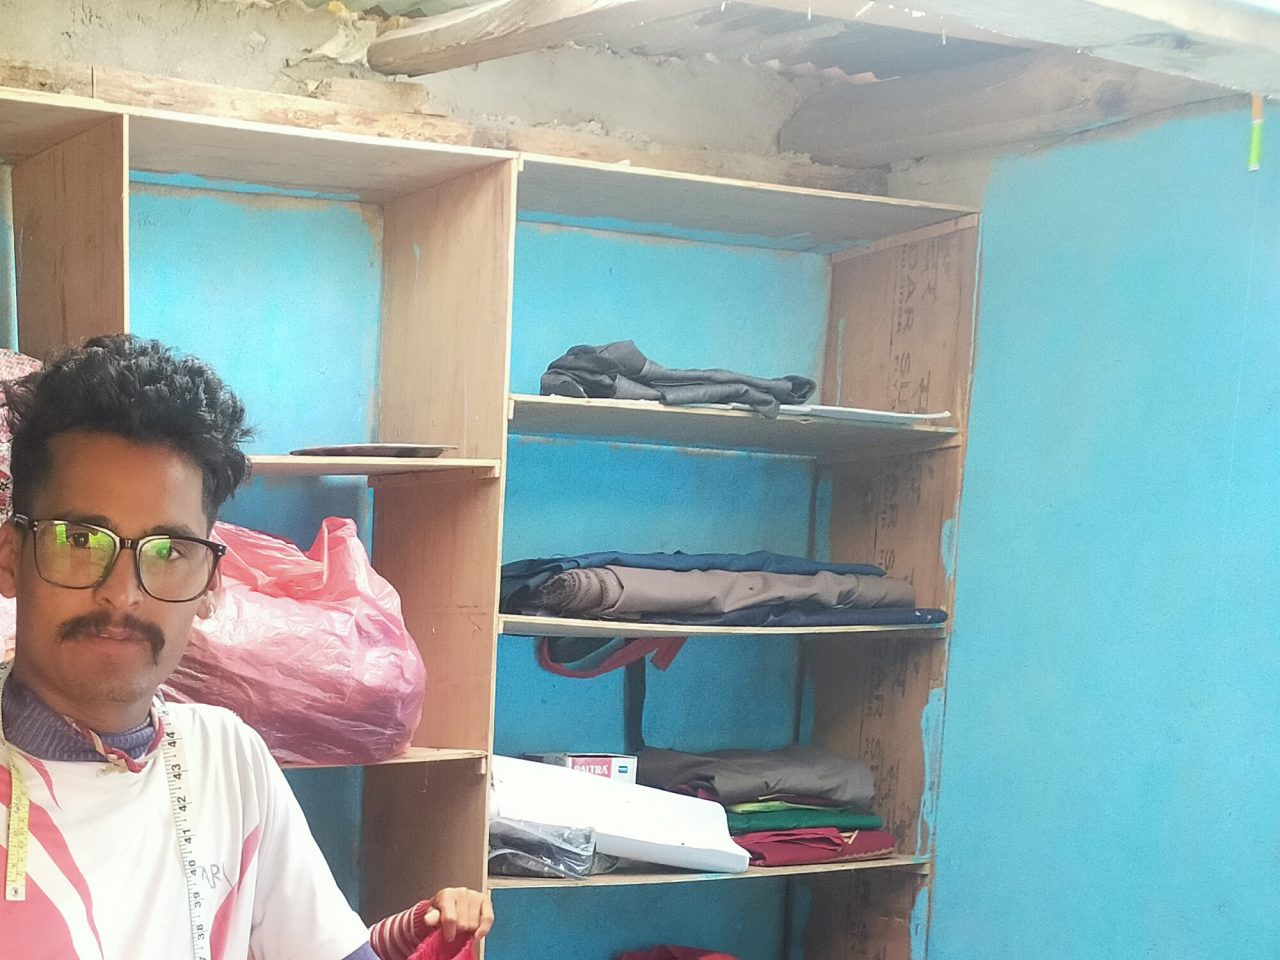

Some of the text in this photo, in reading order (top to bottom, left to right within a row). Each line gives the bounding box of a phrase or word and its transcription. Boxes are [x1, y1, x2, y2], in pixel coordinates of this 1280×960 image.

[168, 732, 177, 748] 44
[172, 764, 182, 780] 43
[177, 796, 187, 812] 42
[184, 828, 193, 844] 41
[188, 860, 198, 876] 40
[193, 891, 202, 908] 39
[196, 924, 205, 940] 38
